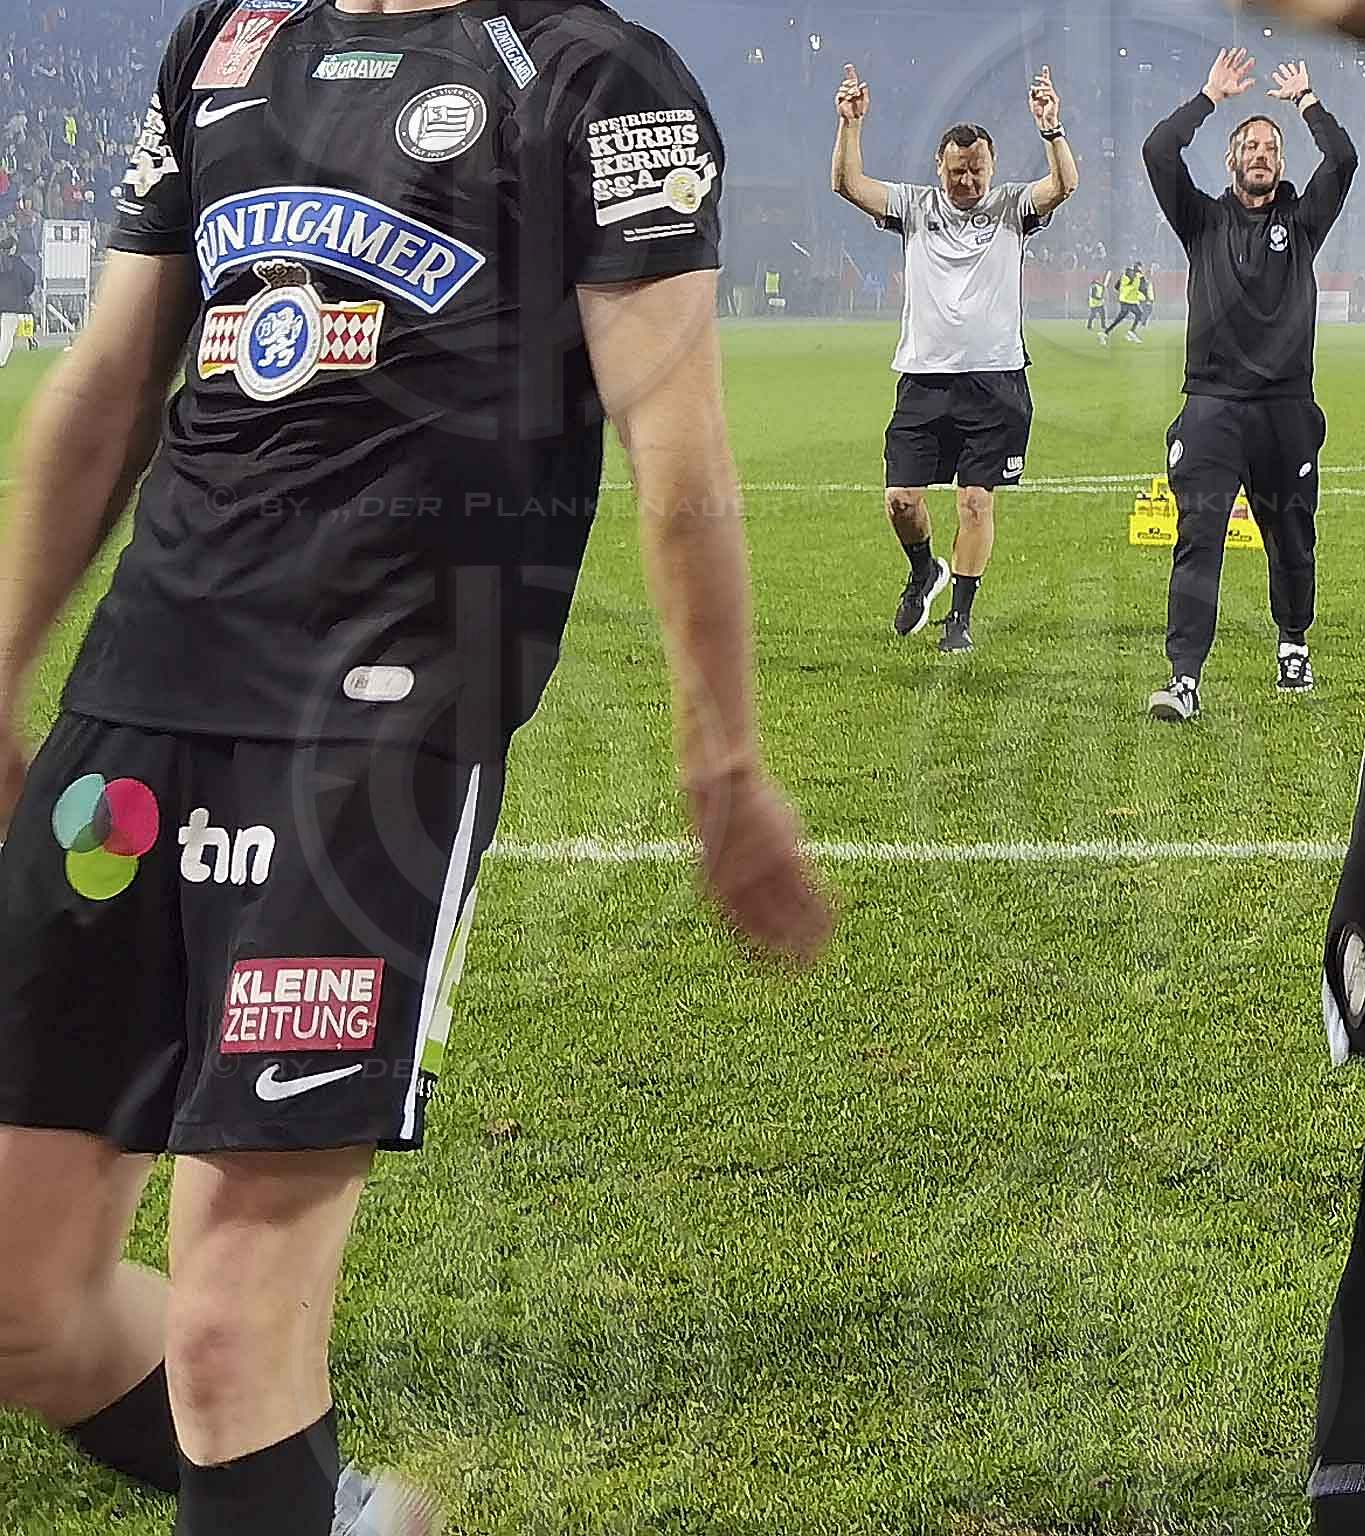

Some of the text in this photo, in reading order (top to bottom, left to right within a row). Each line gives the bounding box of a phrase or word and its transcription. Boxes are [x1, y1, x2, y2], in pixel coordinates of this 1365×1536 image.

[338, 60, 399, 79] GRAWE
[587, 109, 695, 135] STEIRISCHES
[586, 123, 699, 157] KÜRBIS
[590, 145, 706, 178] KERNÖL
[198, 200, 457, 296] PUNTIGAMER
[229, 968, 375, 1005] KLEINE
[223, 1005, 370, 1042] ZEITUNG
